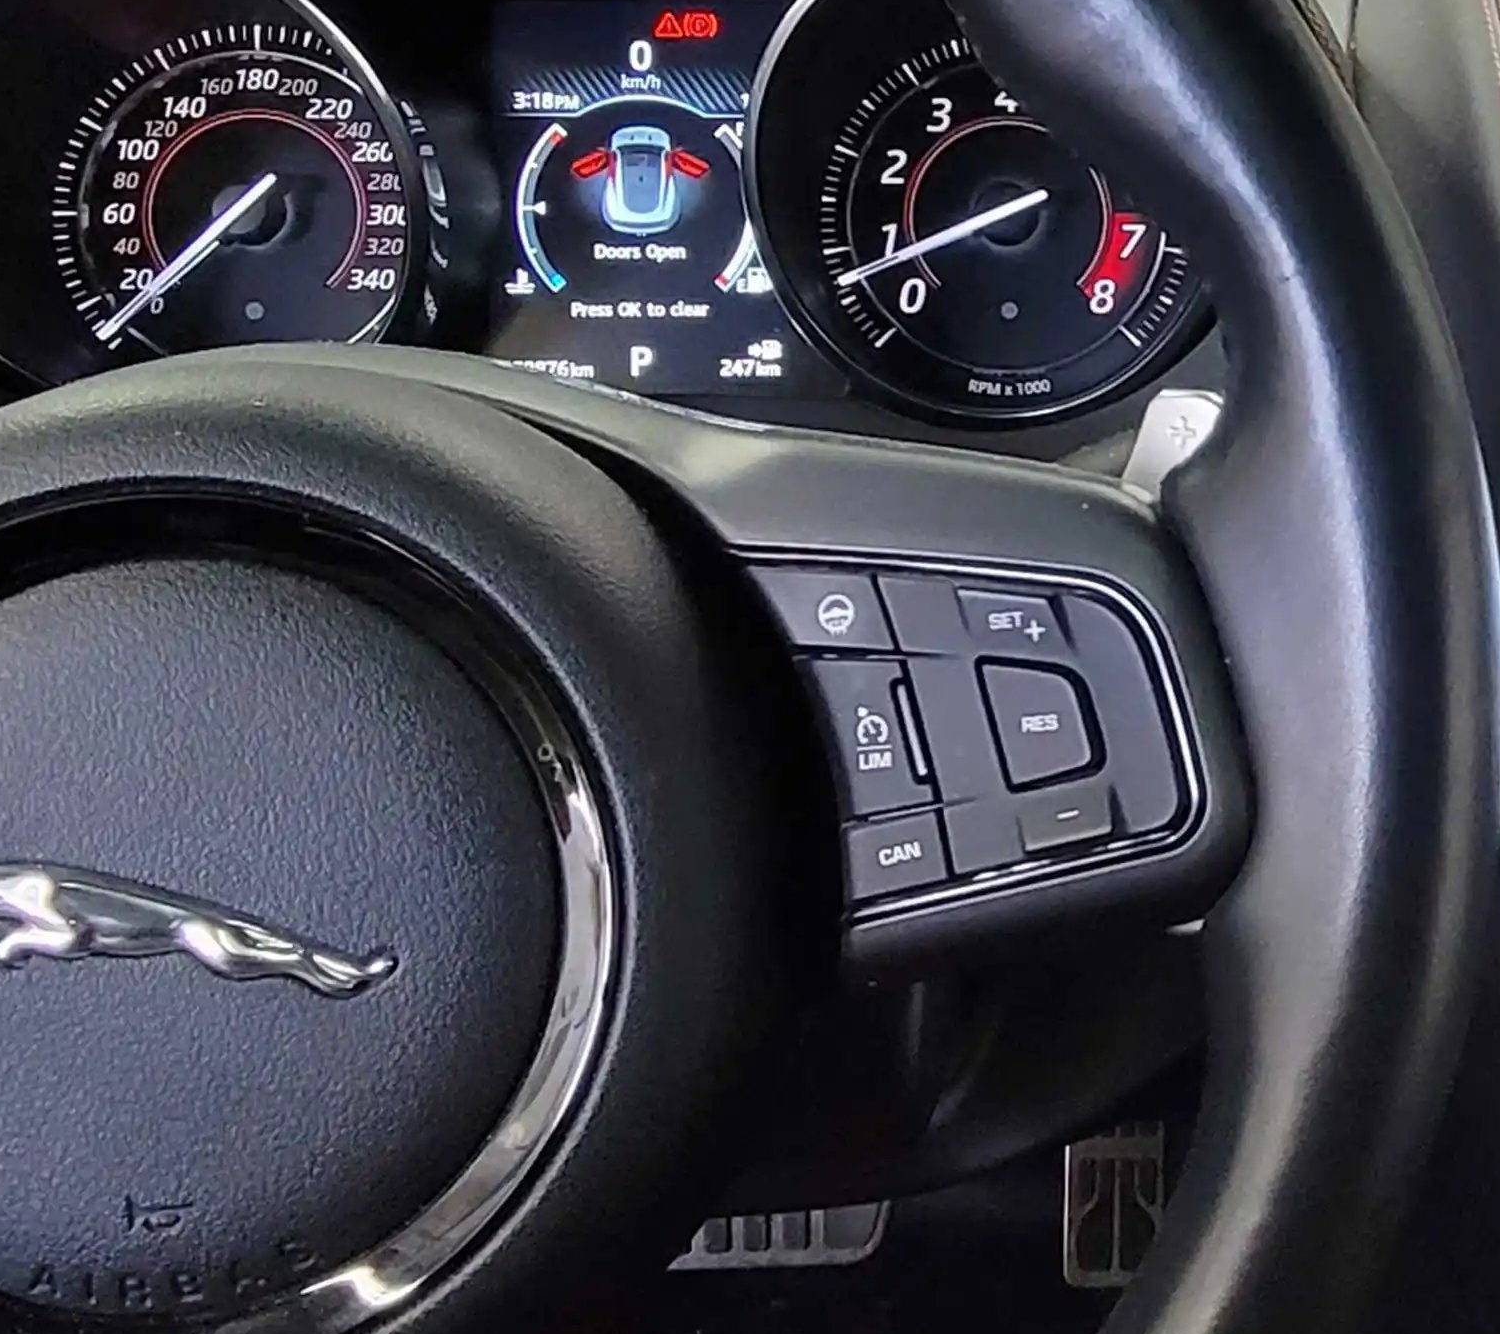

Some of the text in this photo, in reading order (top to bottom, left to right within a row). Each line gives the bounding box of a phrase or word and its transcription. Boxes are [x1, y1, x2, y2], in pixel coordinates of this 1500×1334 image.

[629, 40, 653, 71] 0
[200, 78, 233, 96] 160
[236, 69, 280, 90] 180
[279, 78, 317, 97] 200
[620, 74, 662, 90] km/h
[164, 96, 206, 118] 140
[305, 99, 352, 120] 220
[926, 97, 952, 133] 3
[145, 120, 178, 137] 120
[334, 122, 371, 140] 240
[117, 139, 159, 161] 100
[352, 141, 393, 162] 260
[880, 149, 908, 184] 2
[112, 172, 139, 190] 80
[103, 204, 135, 224] 60
[113, 238, 140, 255] 40
[365, 238, 404, 255] 320
[881, 223, 899, 256] 1
[1118, 223, 1146, 258] 7
[594, 244, 687, 262] Doors Open
[119, 269, 153, 290] 20
[347, 269, 395, 290] 340
[900, 277, 927, 314] 0
[1089, 279, 1116, 314] 8
[150, 298, 164, 315] 0
[570, 302, 710, 318] Press OK to clear
[630, 346, 653, 377] P
[968, 379, 1001, 395] RPM
[1016, 379, 1050, 395] 1000
[989, 611, 1023, 631] SET
[1021, 714, 1059, 733] RES
[858, 752, 892, 769] LIM
[878, 841, 922, 866] CAN
